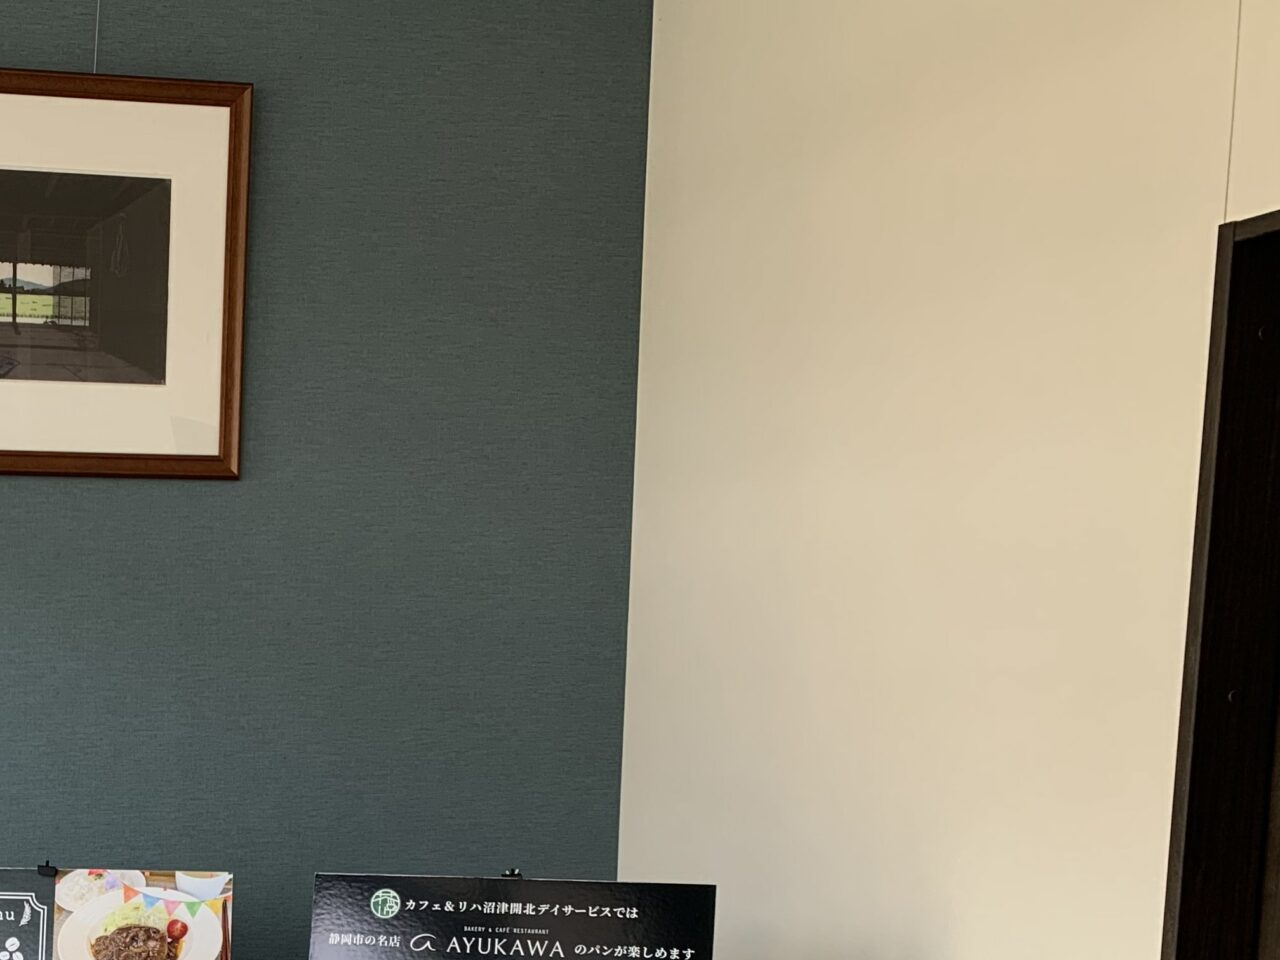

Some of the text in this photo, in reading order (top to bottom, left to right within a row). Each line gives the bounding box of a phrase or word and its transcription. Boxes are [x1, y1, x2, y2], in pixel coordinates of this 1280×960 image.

[463, 925, 485, 933] BAKERY
[512, 927, 549, 935] RESTAURANT
[328, 932, 401, 948] 静岡市の名店
[446, 936, 565, 958] AYUKAWA
[574, 943, 696, 960] のパンが楽しめます
